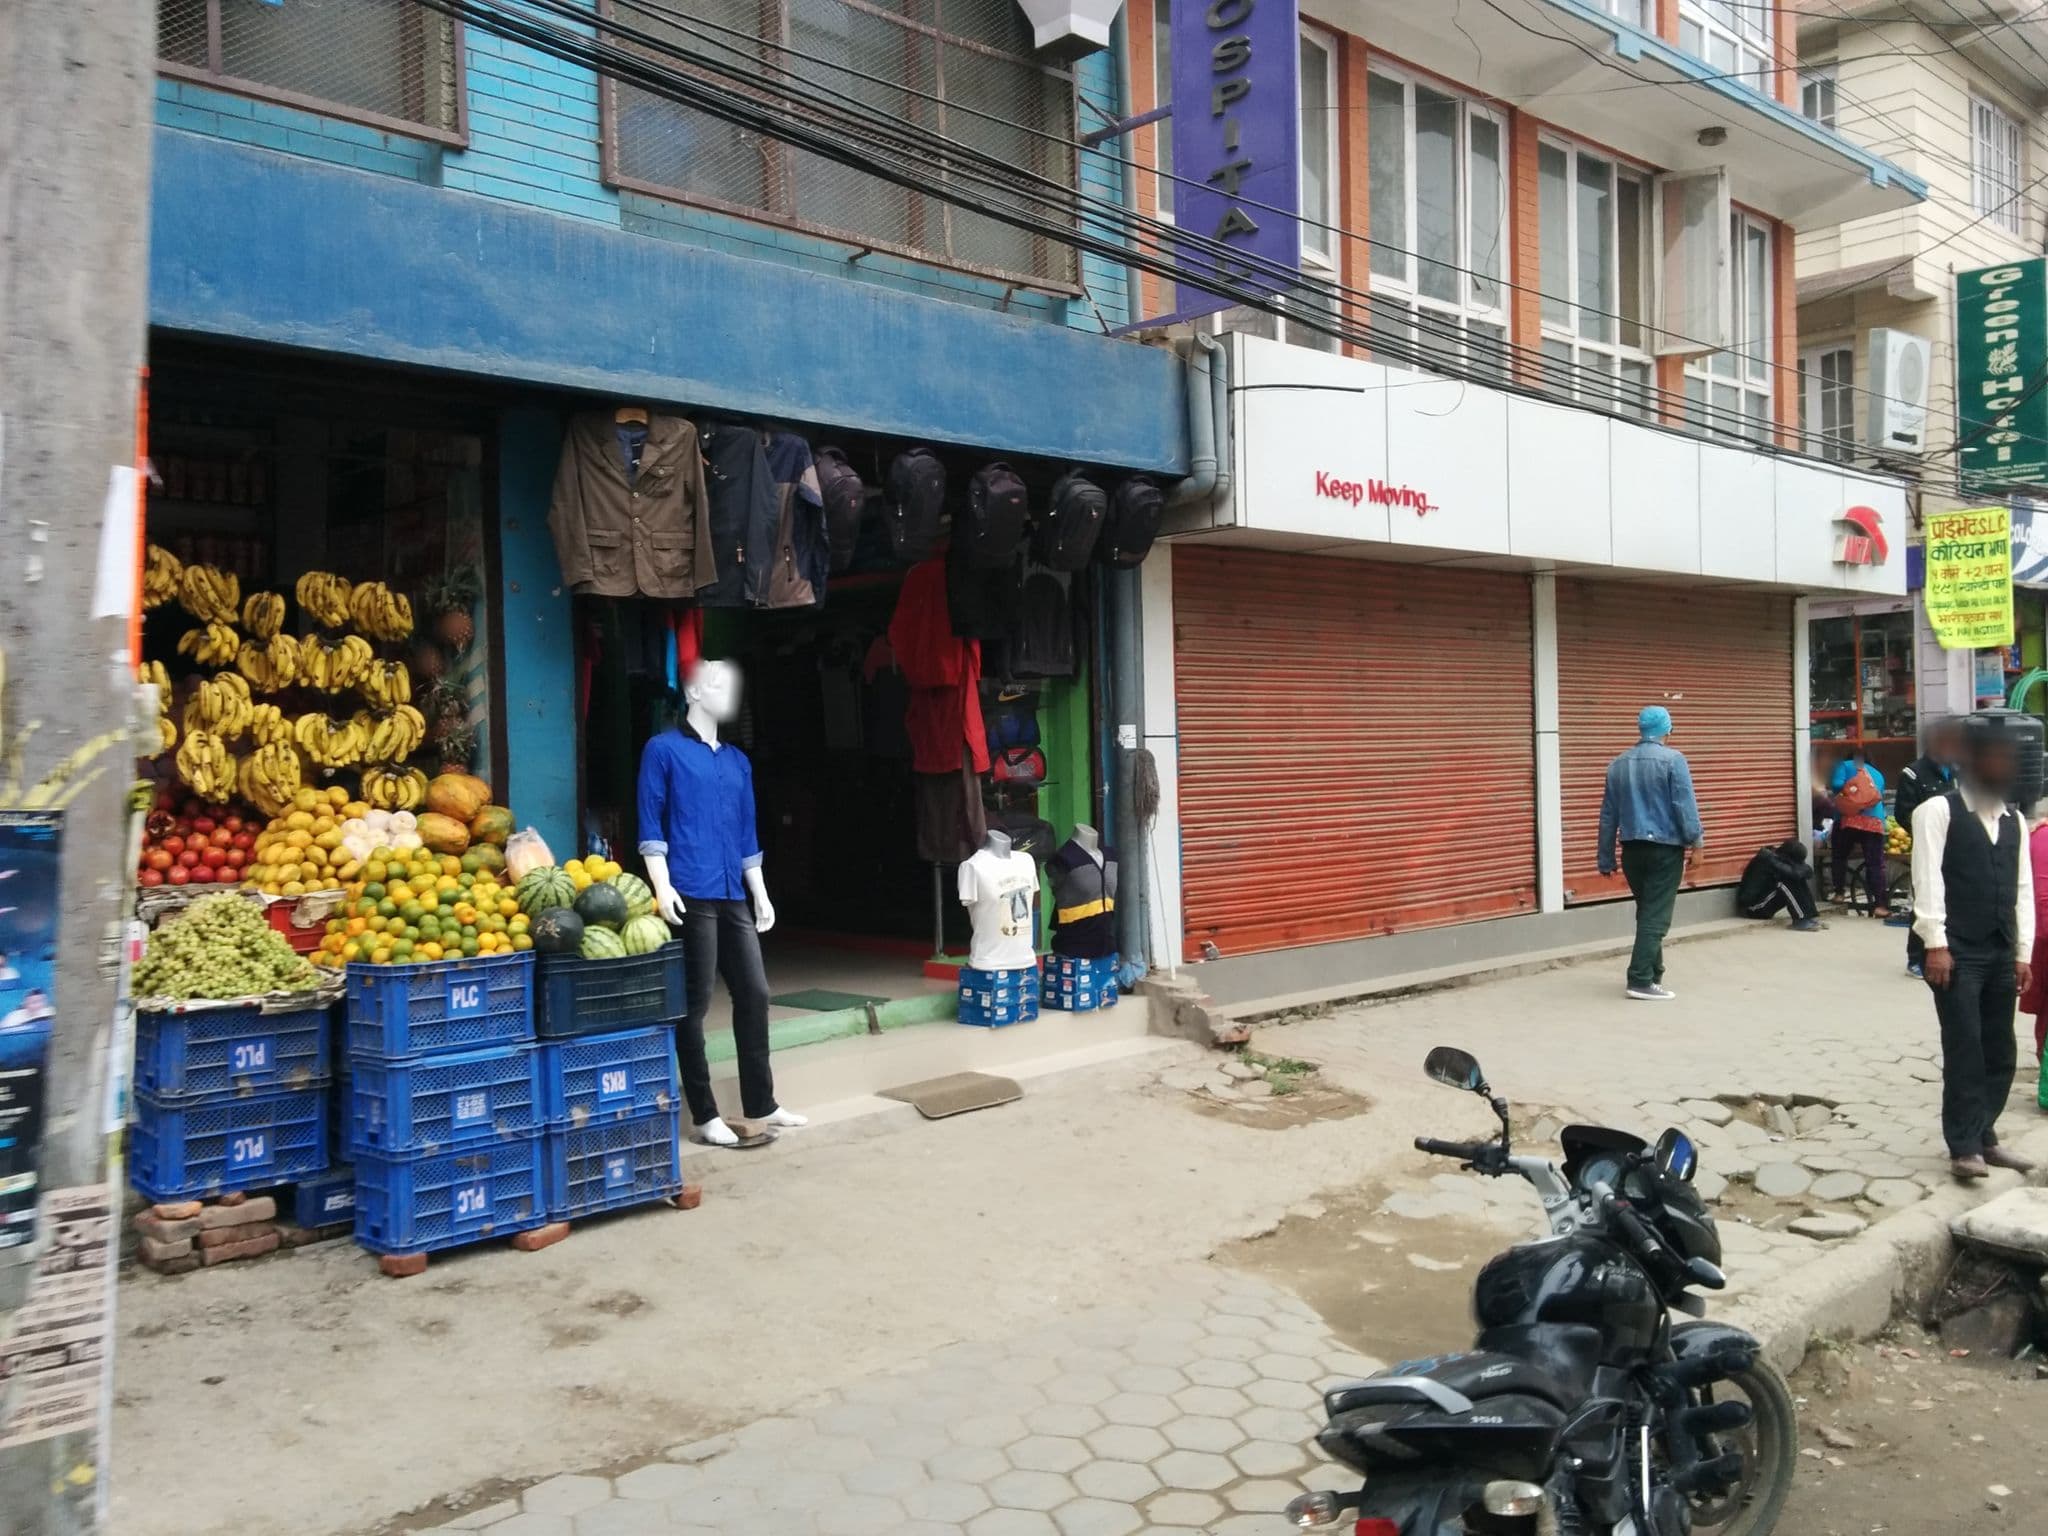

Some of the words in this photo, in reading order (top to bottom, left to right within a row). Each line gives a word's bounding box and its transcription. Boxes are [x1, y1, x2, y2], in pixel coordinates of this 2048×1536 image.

[1316, 470, 1364, 507] Keep
[452, 985, 479, 1009] PLC
[234, 1043, 265, 1069] PLC
[602, 1070, 626, 1094] RKS
[233, 1135, 264, 1162] PLC
[458, 1186, 485, 1214] PLC
